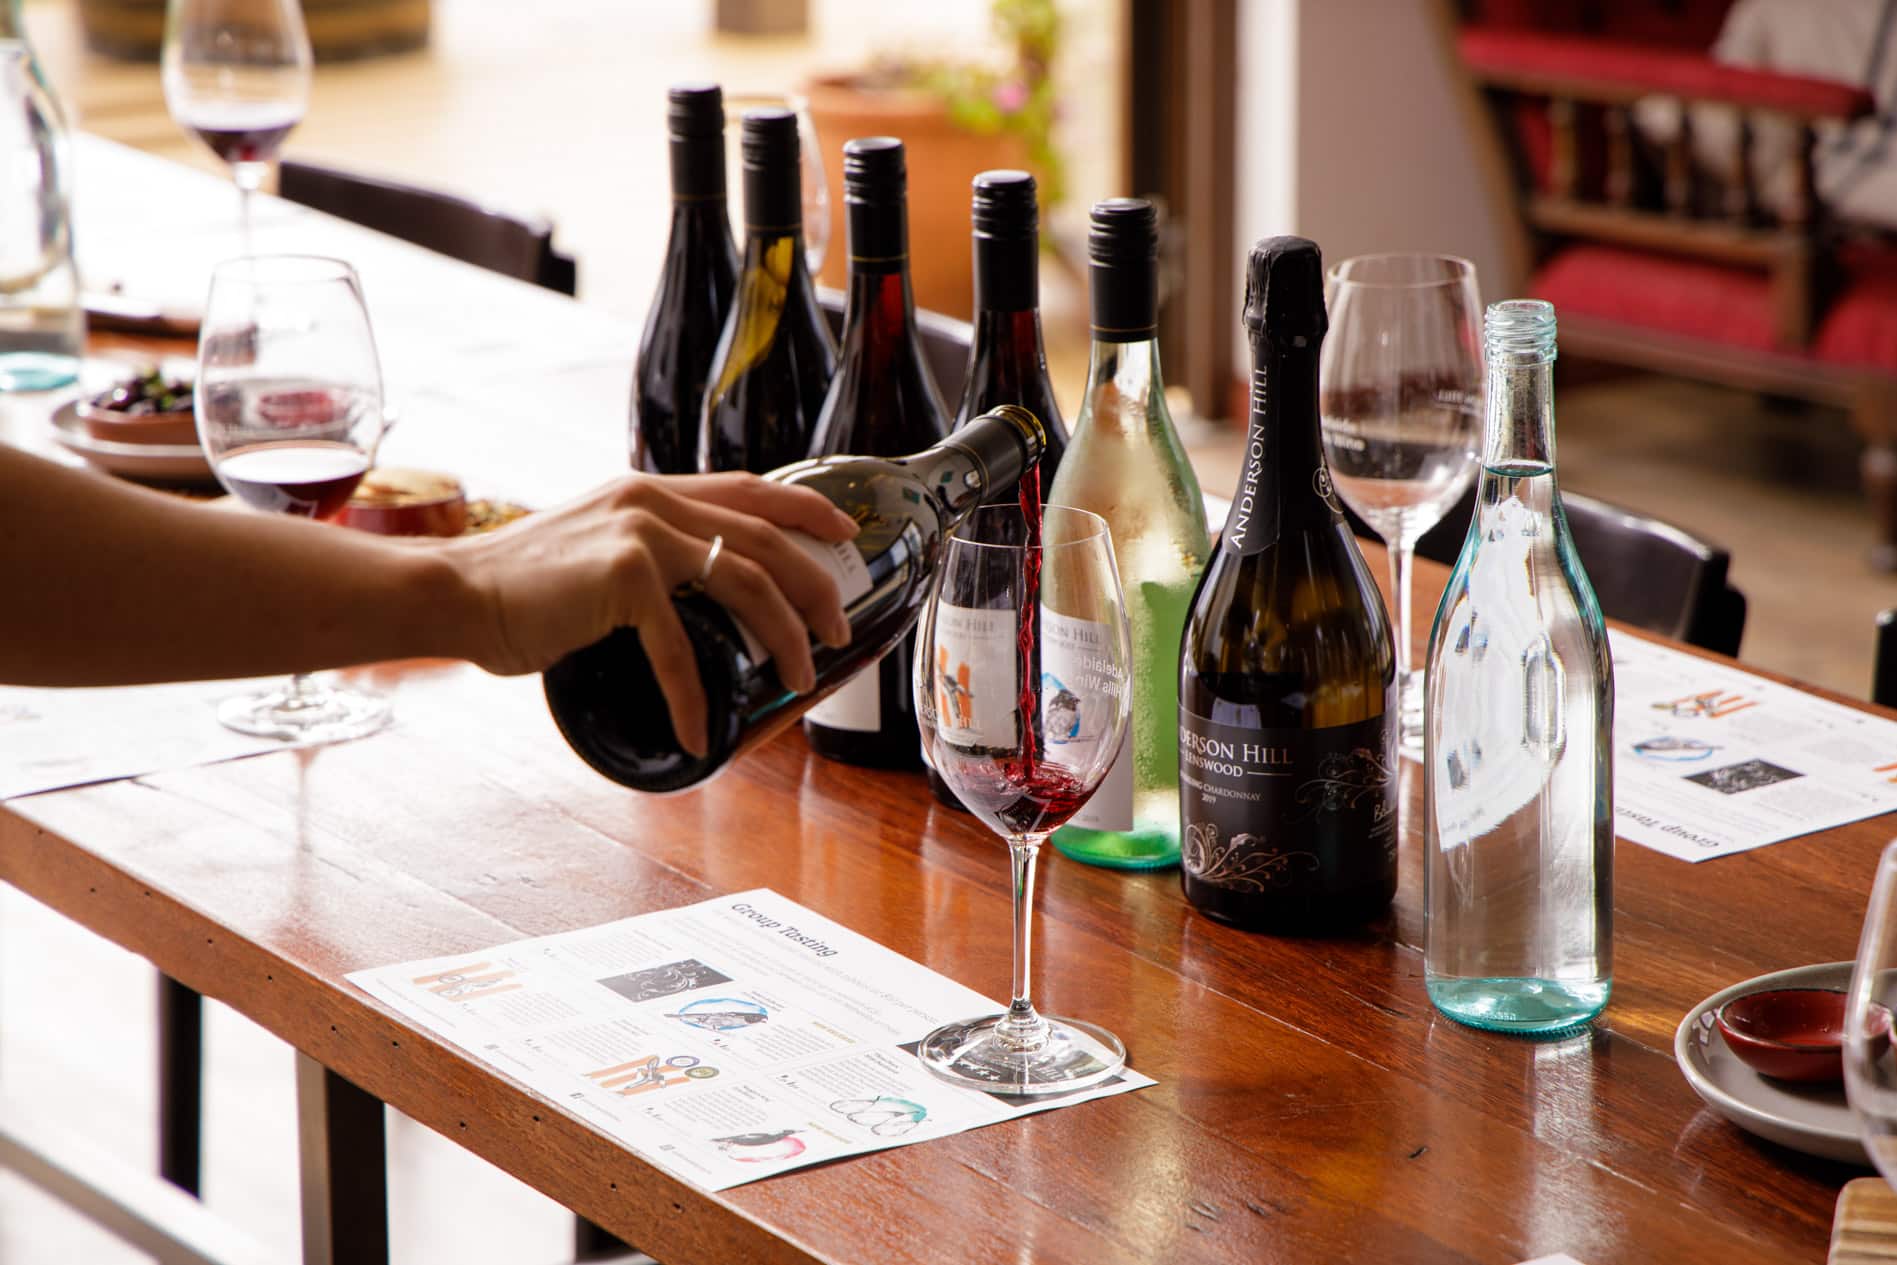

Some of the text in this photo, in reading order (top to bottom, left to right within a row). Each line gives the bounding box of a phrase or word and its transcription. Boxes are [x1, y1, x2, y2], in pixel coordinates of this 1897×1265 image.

[1230, 365, 1268, 549] ANDERSON HILL
[1180, 725, 1295, 764] DERSON HILL
[1203, 783, 1262, 801] CHARDONNAY
[1660, 824, 1720, 848] Group
[731, 903, 782, 928] Group
[778, 926, 838, 957] Tasting
